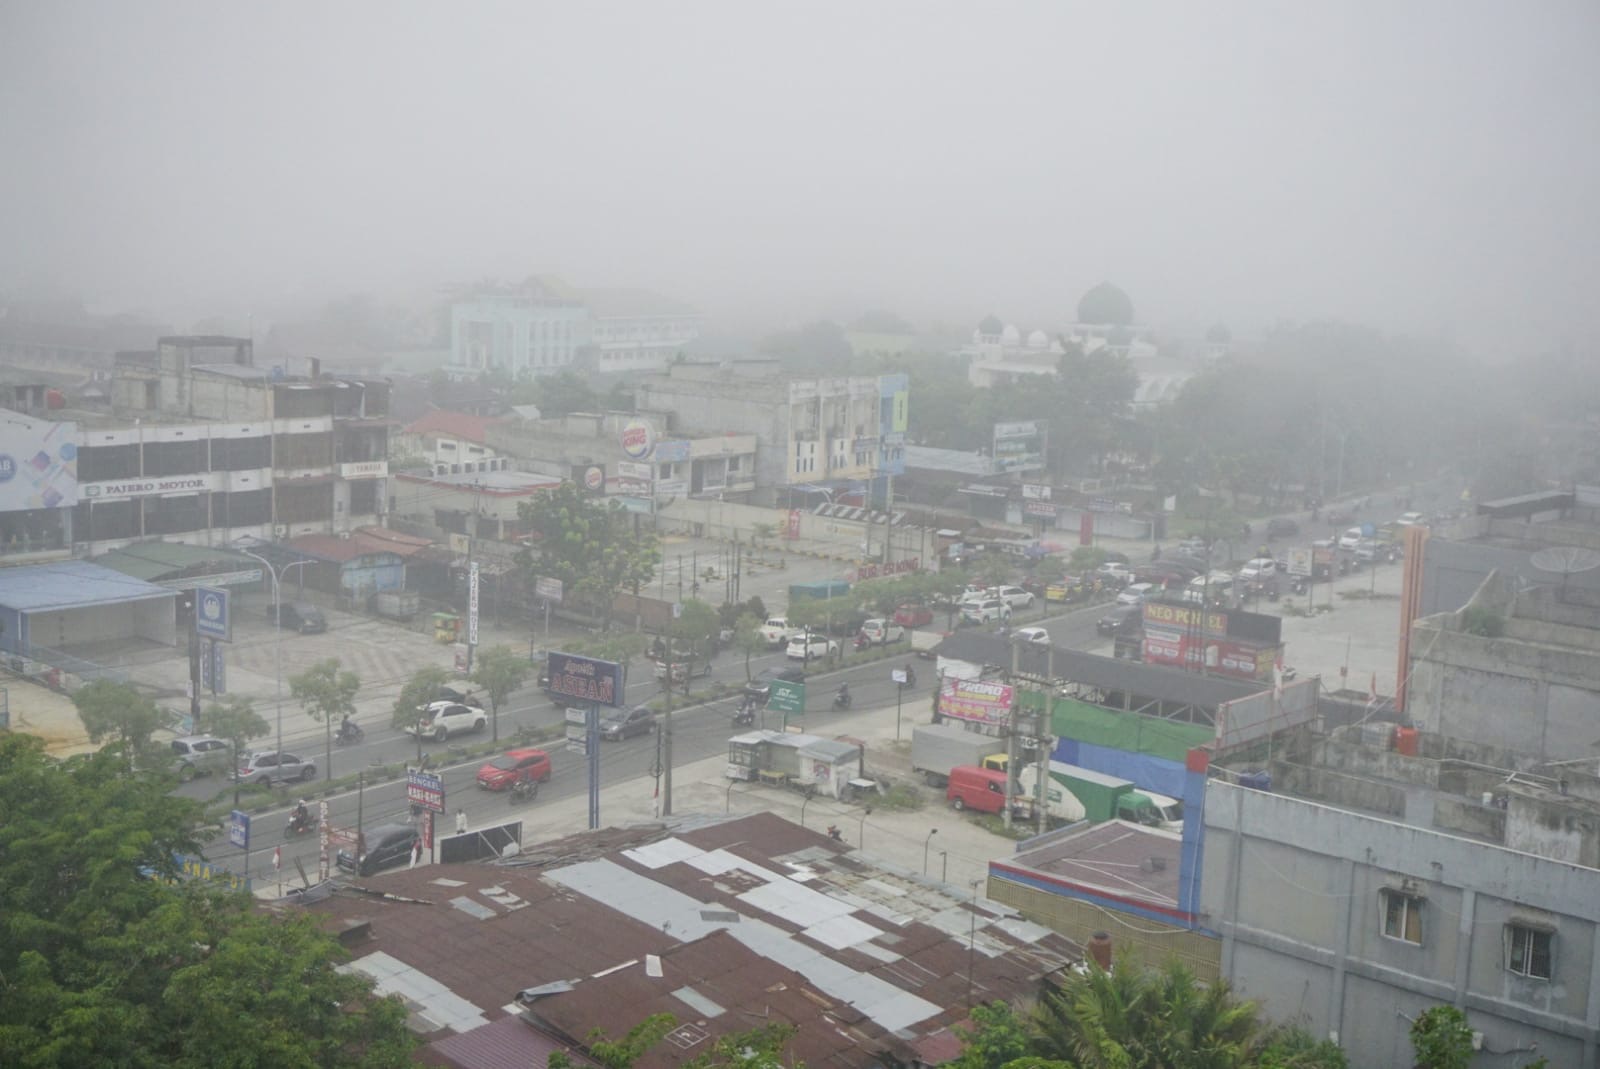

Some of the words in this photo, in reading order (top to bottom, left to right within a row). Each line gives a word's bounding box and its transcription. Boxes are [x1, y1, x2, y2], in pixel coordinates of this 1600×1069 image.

[623, 435, 647, 449] KING
[105, 482, 154, 495] PAJERO
[158, 479, 205, 490] MOTOR
[858, 561, 895, 578] BURER
[896, 557, 919, 573] KING
[1147, 604, 1173, 621] NEO
[1175, 608, 1225, 630] PONEL
[551, 672, 614, 703] ASEAN
[957, 682, 1004, 697] PROMO
[408, 775, 442, 791] BENGKEL
